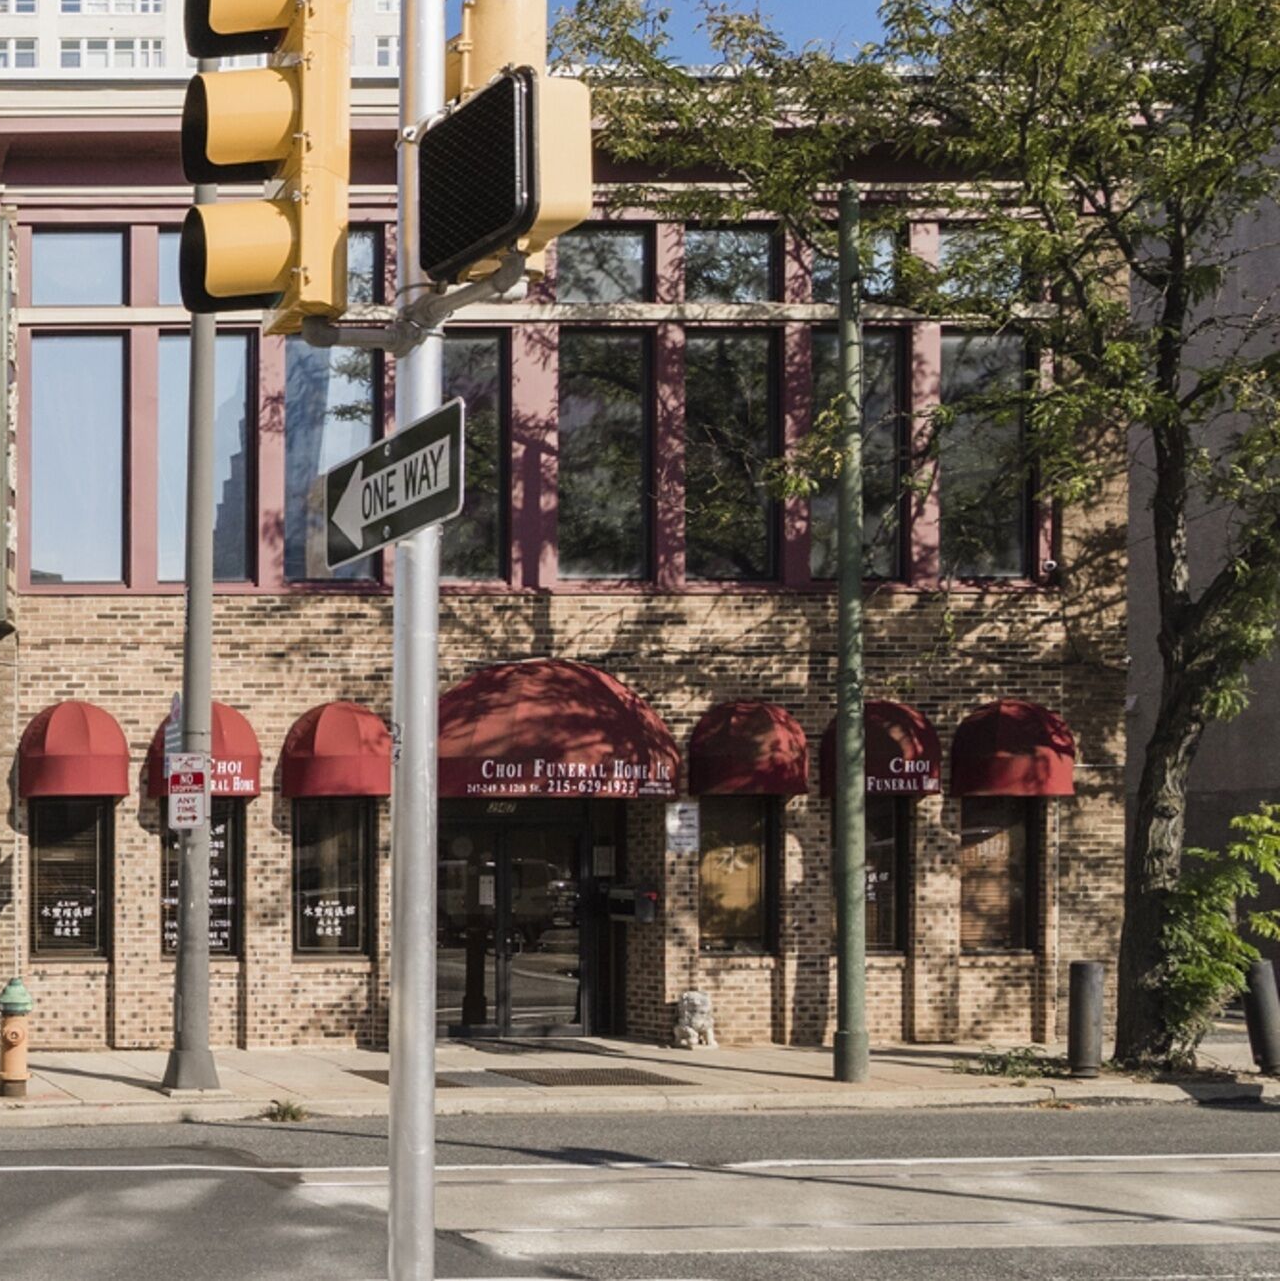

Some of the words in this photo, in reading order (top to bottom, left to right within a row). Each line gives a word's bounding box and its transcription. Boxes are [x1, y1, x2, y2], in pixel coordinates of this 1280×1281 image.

[361, 470, 397, 520] ONE
[403, 444, 445, 501] WAY
[481, 759, 523, 779] CHOI
[533, 758, 607, 778] FUNERAL
[889, 757, 930, 773] CHOI
[180, 774, 194, 785] NO
[547, 779, 636, 795] 215-629-1923
[866, 776, 919, 791] FUNERAL
